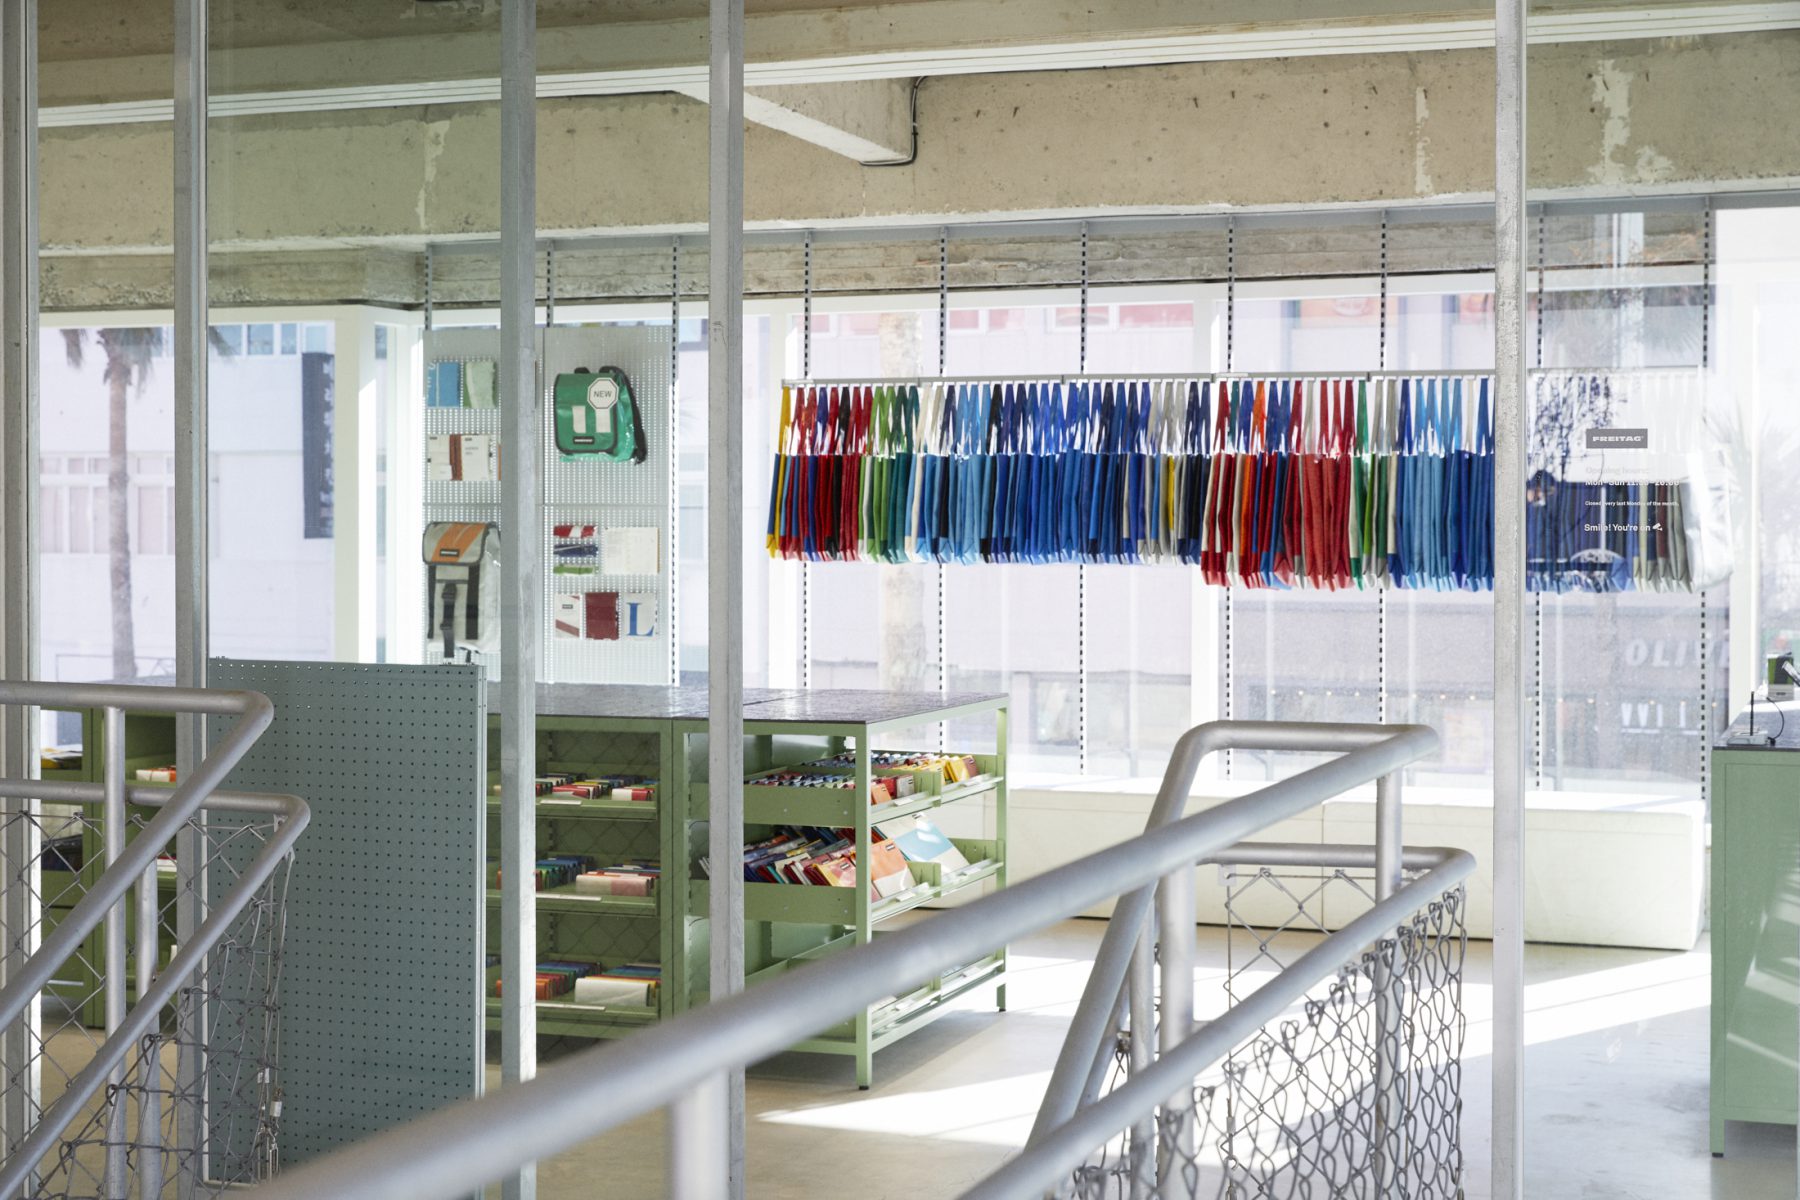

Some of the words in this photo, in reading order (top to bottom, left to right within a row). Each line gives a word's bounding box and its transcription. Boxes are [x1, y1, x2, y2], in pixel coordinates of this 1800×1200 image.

[593, 390, 613, 398] NEW
[1584, 523, 1611, 532] Smile!
[1612, 523, 1638, 532] You're
[1639, 524, 1651, 532] on
[626, 602, 655, 637] L
